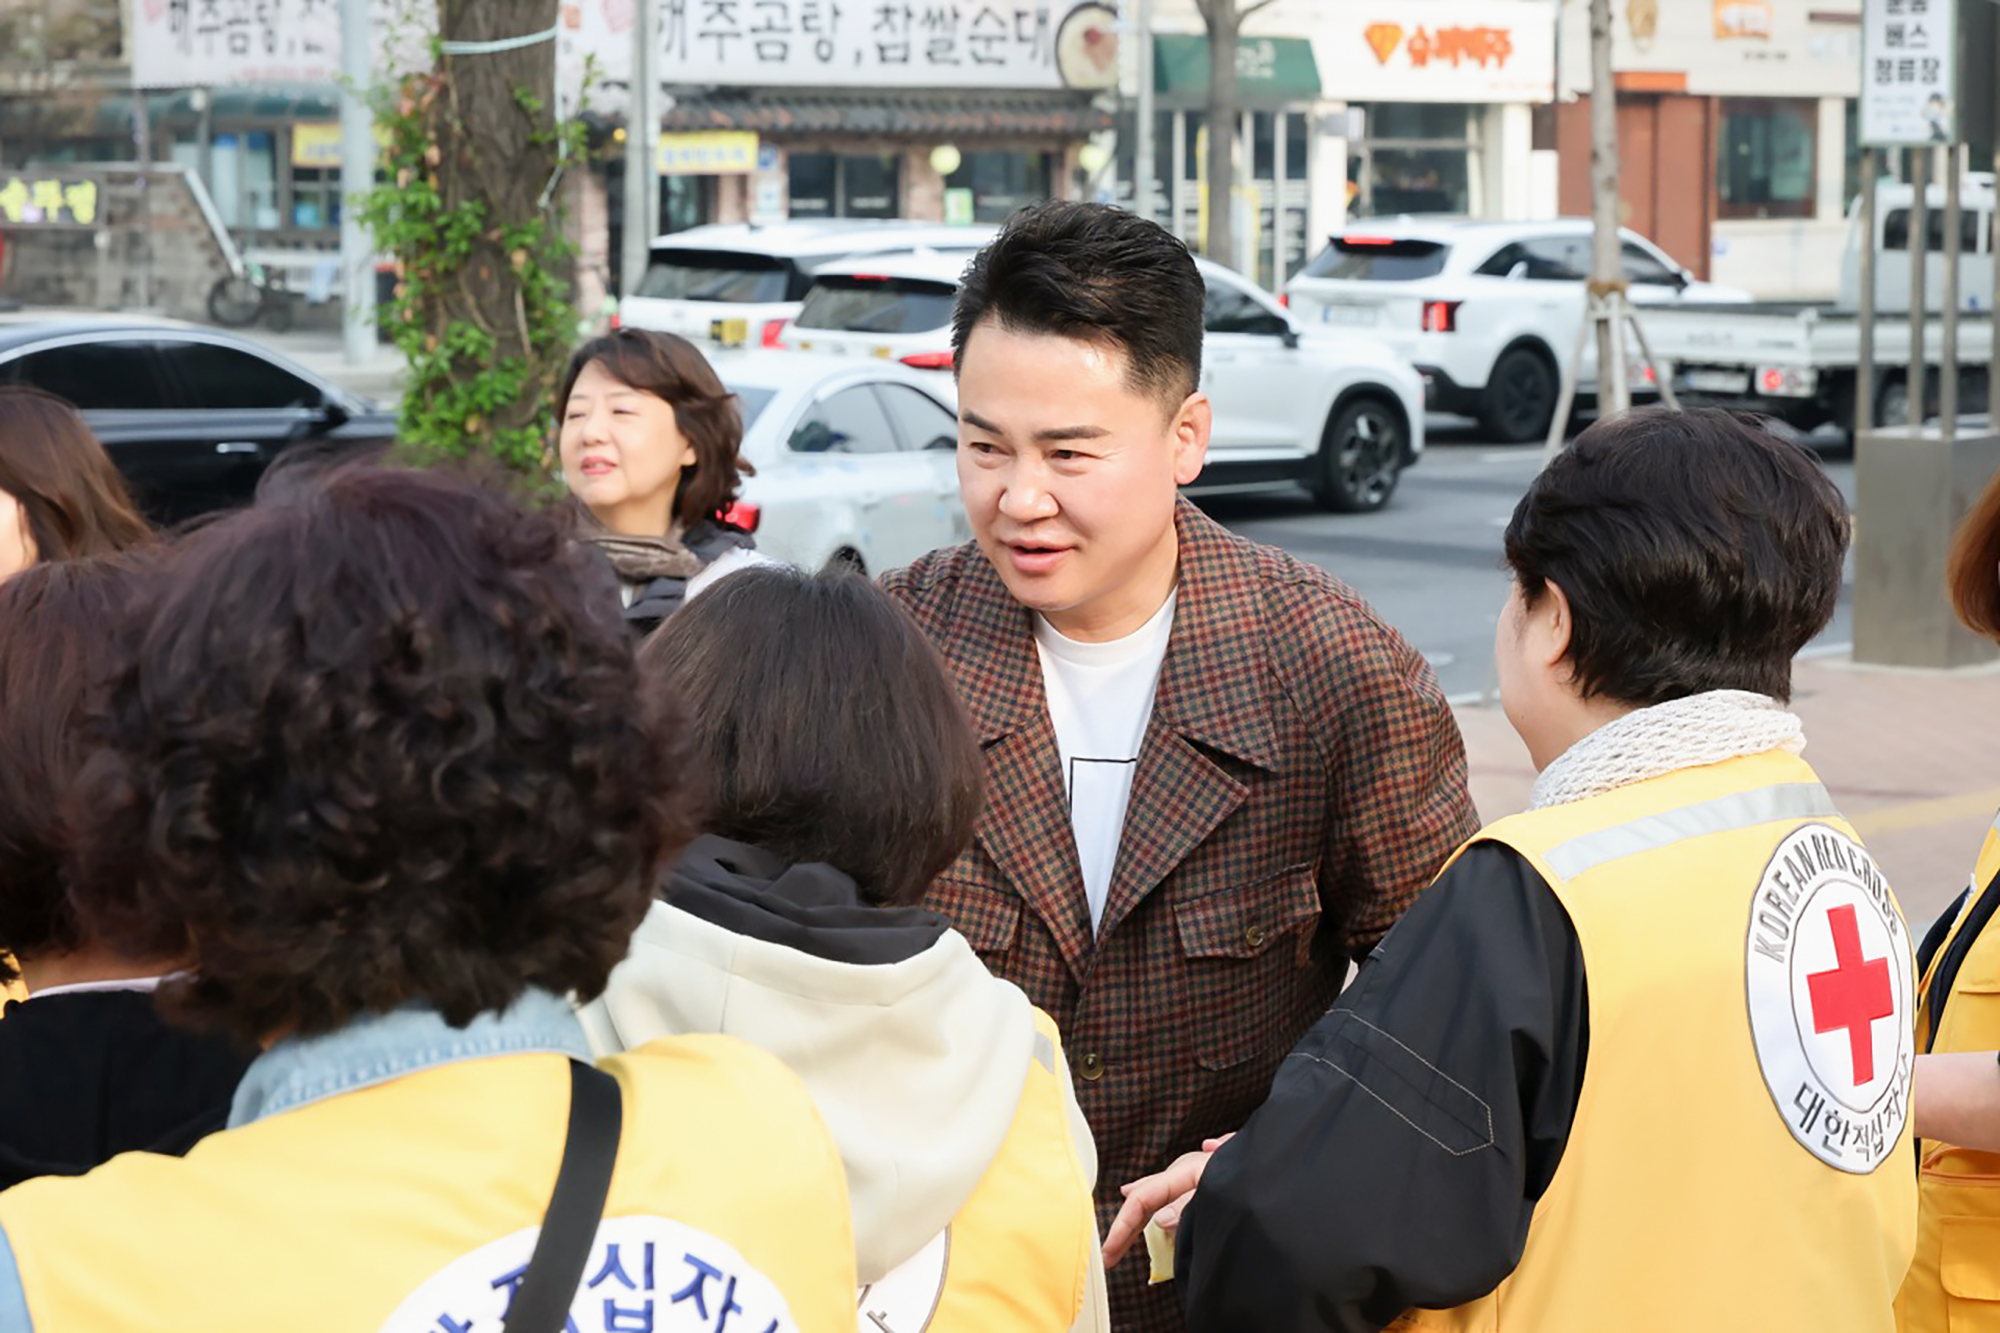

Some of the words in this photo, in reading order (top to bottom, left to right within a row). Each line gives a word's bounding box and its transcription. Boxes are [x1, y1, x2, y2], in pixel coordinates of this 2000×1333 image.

[1755, 842, 1817, 964] KOREAN
[1812, 832, 1849, 873] RED
[1848, 845, 1899, 936] CROSS
